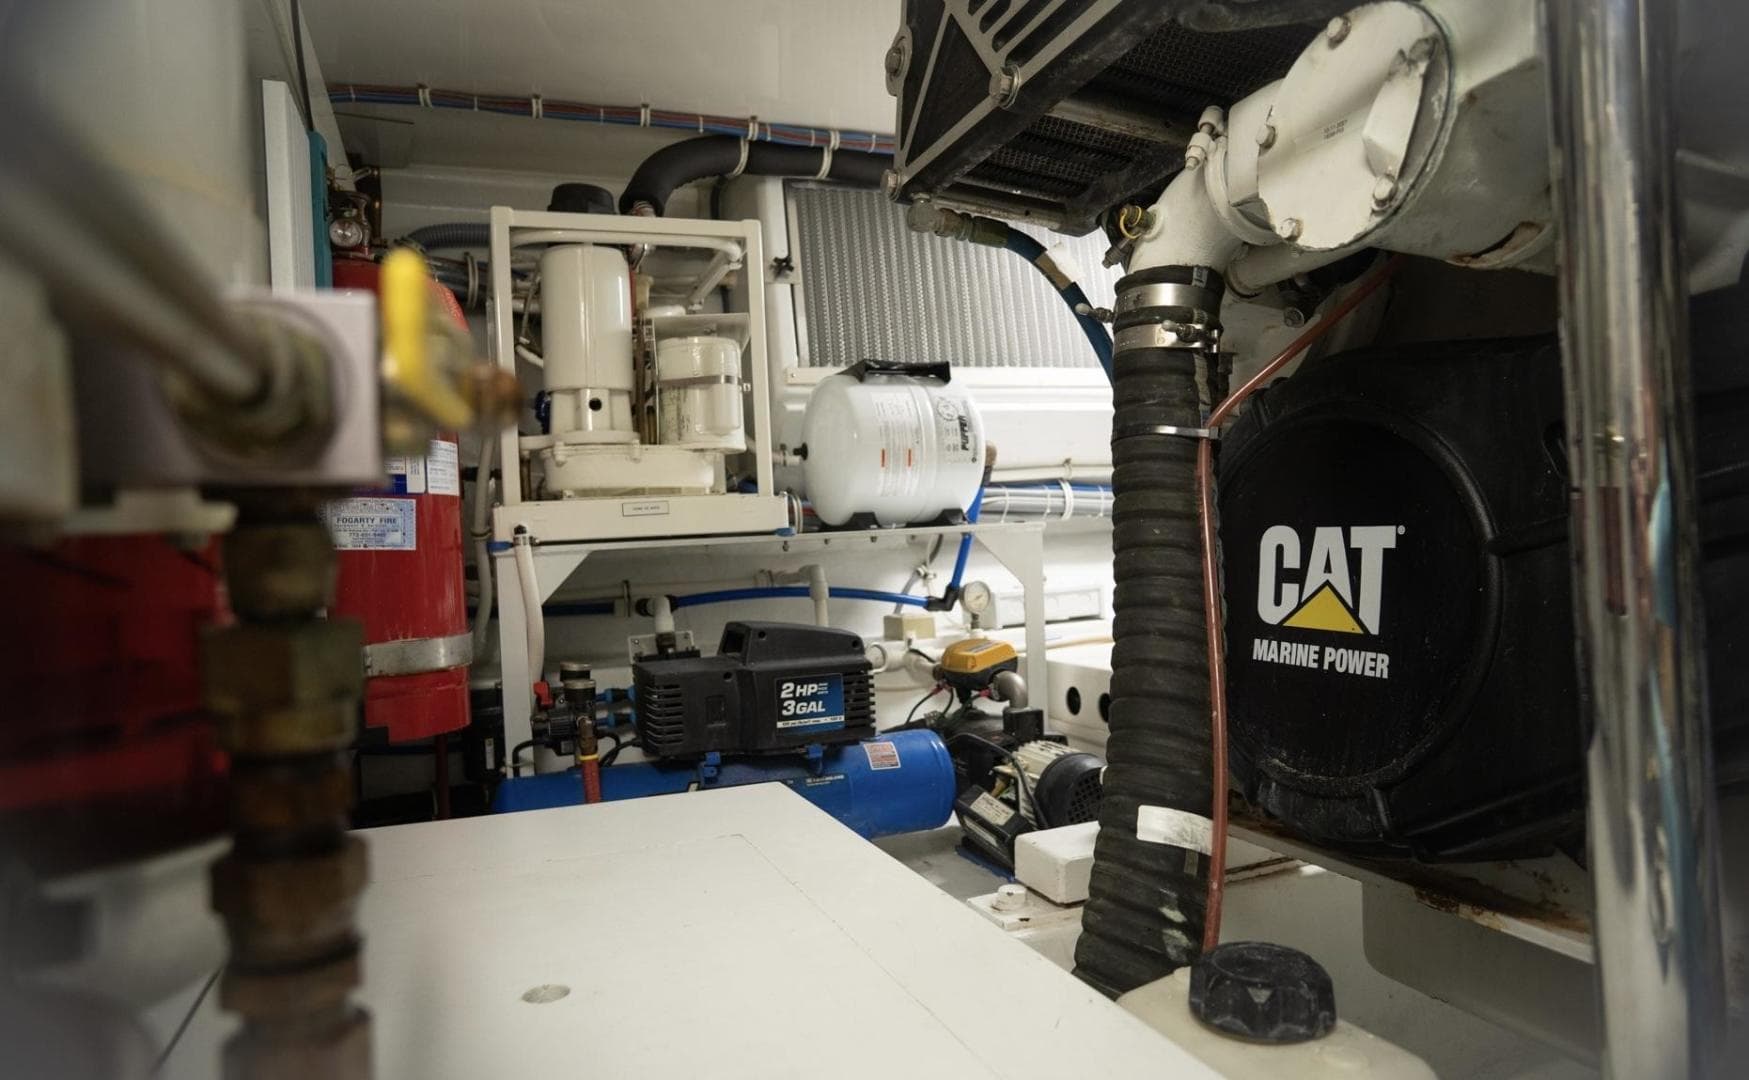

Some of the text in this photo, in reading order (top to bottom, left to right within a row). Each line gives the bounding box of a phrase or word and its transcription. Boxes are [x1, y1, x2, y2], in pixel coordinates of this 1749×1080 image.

[1258, 525, 1397, 636] CAT
[1252, 638, 1390, 679] MARINE POWER
[780, 682, 795, 698] 2
[796, 683, 818, 697] HP
[782, 699, 826, 716] 3 GAL
